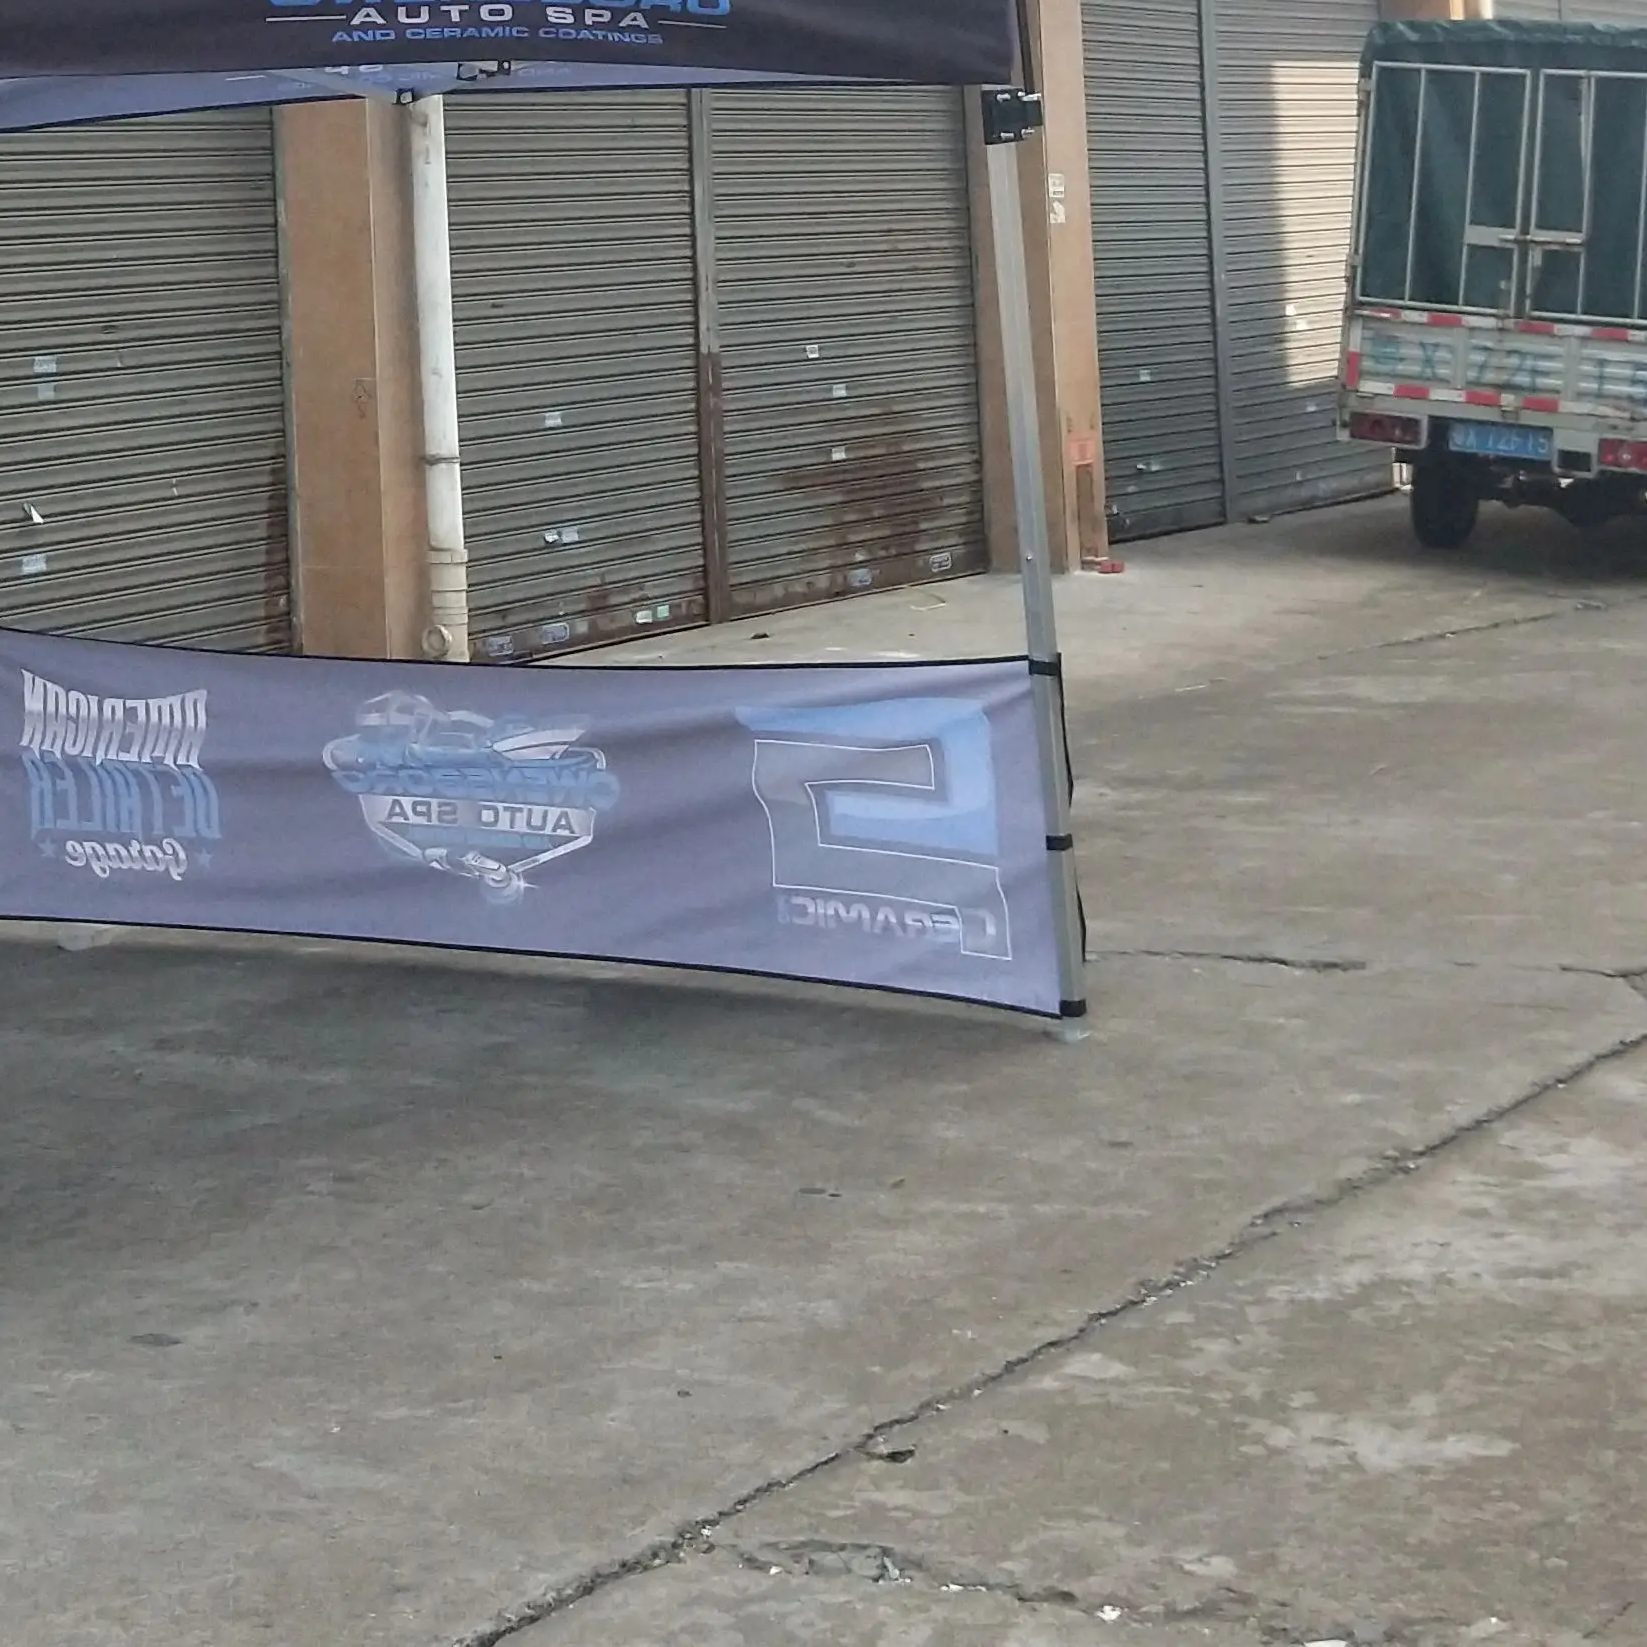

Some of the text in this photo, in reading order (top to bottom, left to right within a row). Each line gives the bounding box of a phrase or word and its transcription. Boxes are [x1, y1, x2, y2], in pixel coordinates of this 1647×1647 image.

[349, 3, 651, 30] AUTO SPA
[331, 26, 664, 45] AND CERAMIC COATINGS
